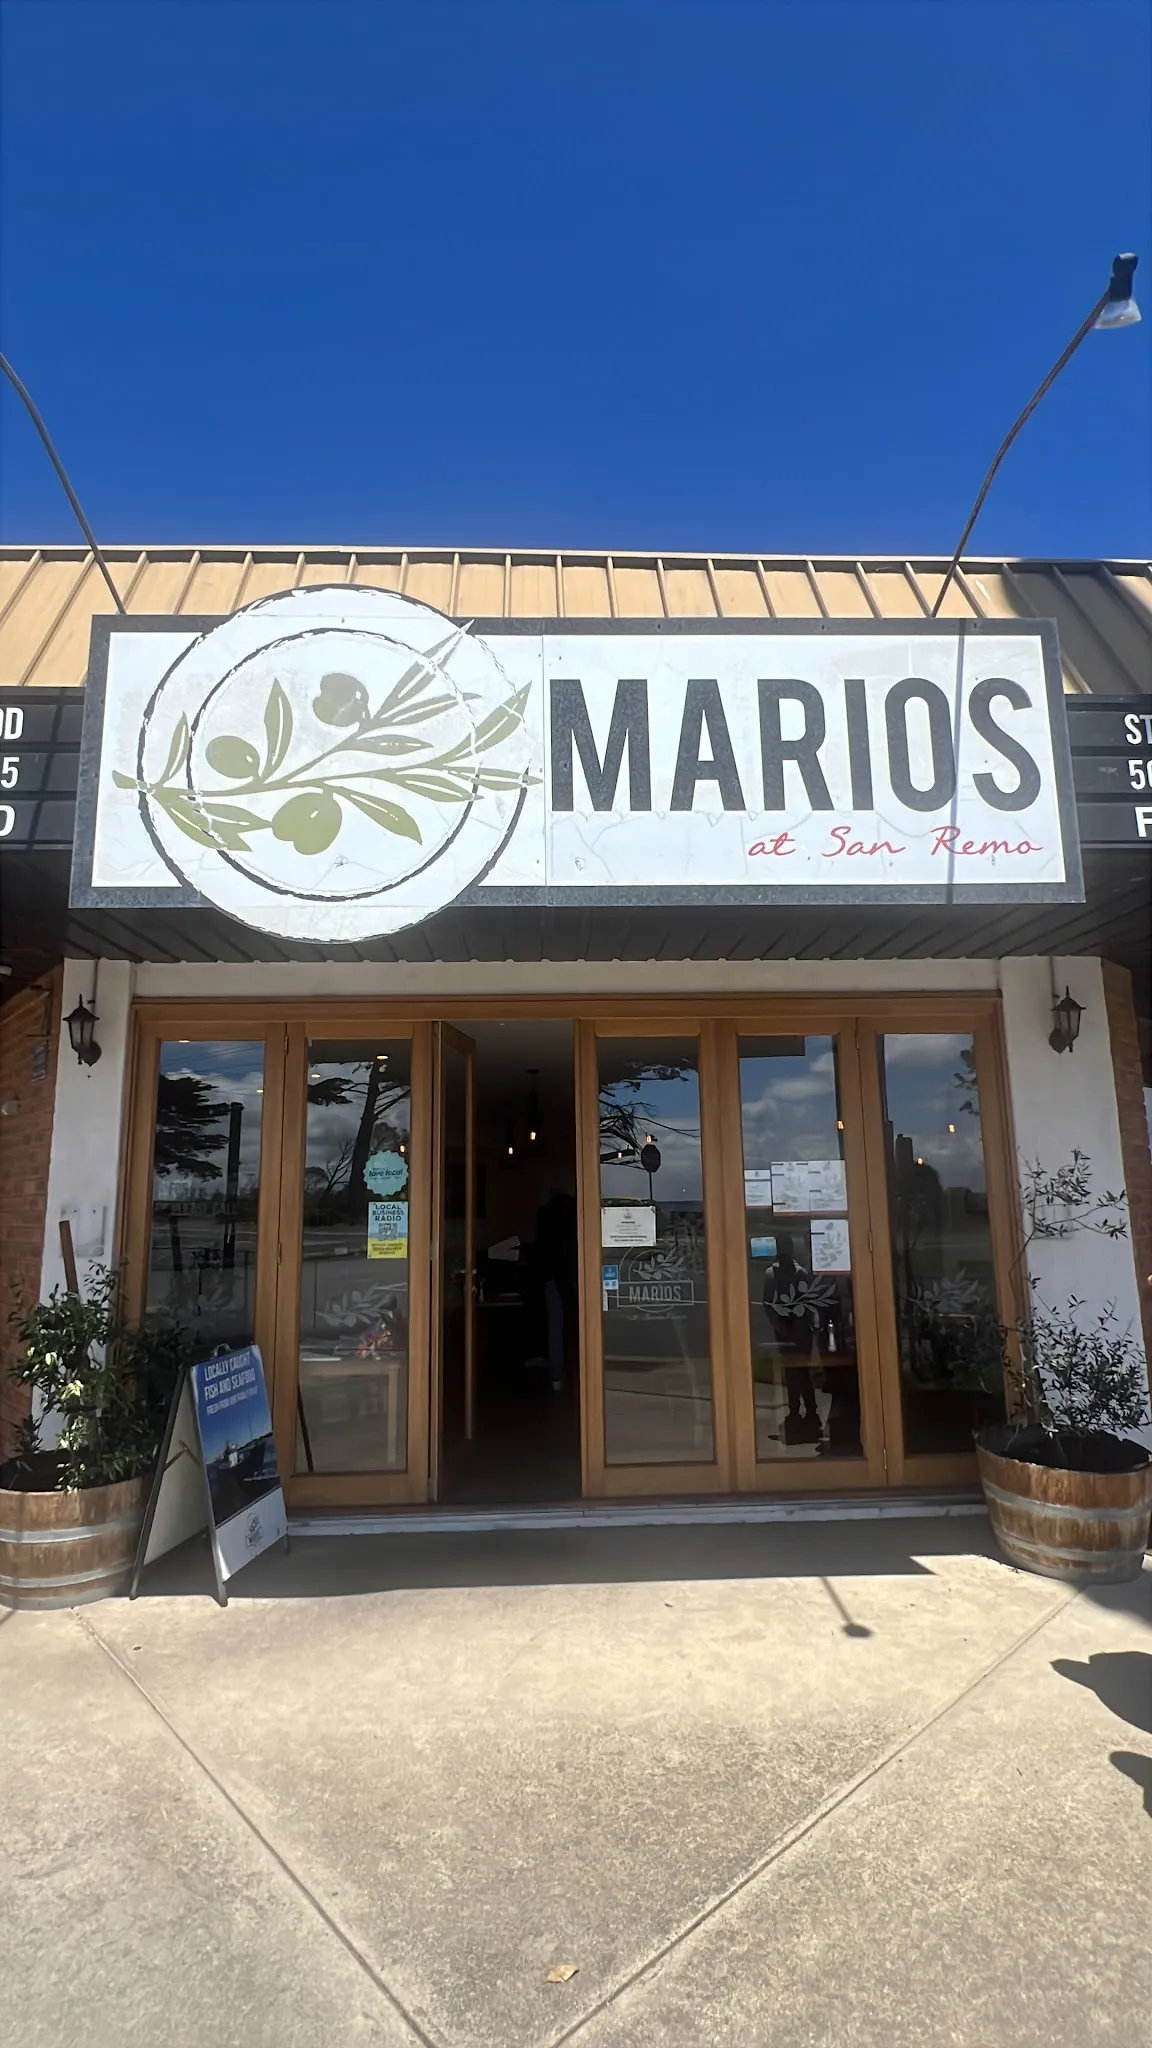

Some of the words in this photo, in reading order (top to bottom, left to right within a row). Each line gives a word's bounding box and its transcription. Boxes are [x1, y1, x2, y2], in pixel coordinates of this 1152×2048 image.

[0, 706, 25, 740] D
[549, 677, 1042, 812] MARIOS
[748, 832, 797, 857] at
[821, 825, 907, 858] San
[930, 825, 1044, 857] Remo
[629, 1285, 682, 1303] MARIOS
[204, 1360, 229, 1382] LOCALLY
[204, 1383, 219, 1401] FISH
[219, 1377, 232, 1394] AND
